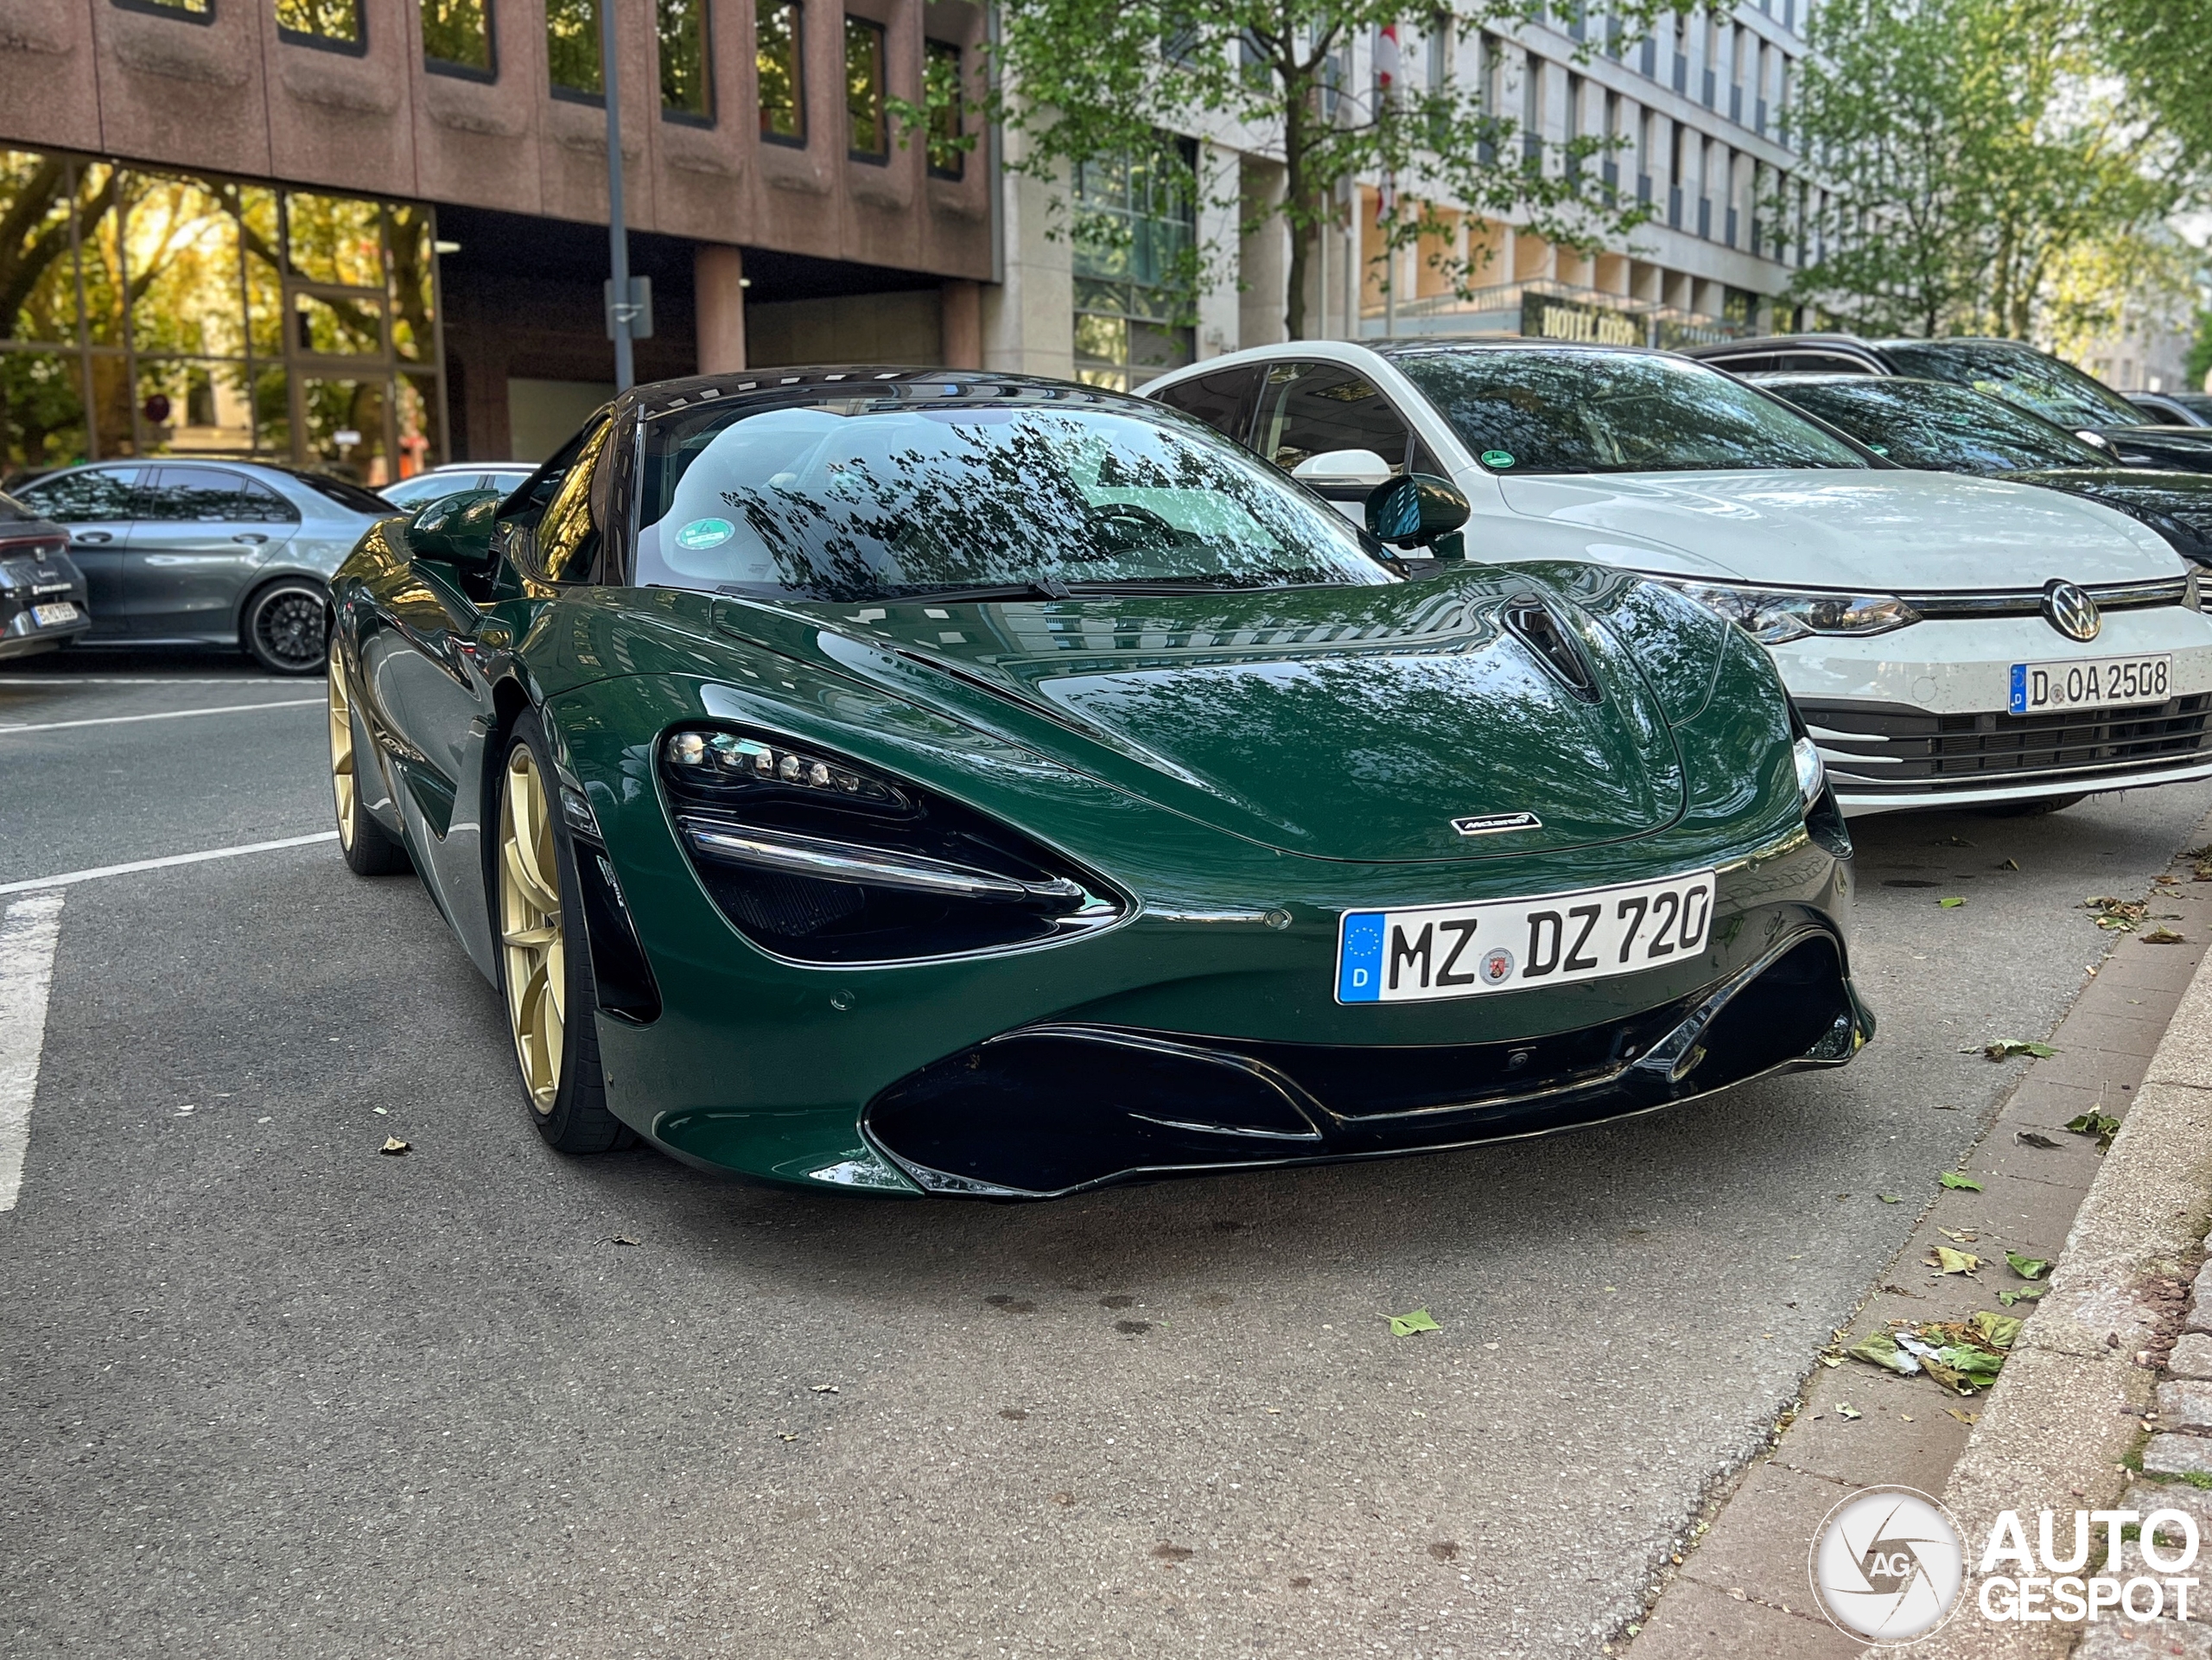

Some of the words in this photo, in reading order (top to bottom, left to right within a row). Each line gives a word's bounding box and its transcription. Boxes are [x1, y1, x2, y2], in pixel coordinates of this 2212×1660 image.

[1542, 305, 1592, 342] HOTEL
[698, 522, 711, 533] 4
[2031, 670, 2049, 705] D
[2067, 665, 2101, 703] OA
[2107, 661, 2167, 699] 2508
[2014, 693, 2022, 704] D
[1465, 817, 1528, 830] McLaren
[1389, 918, 1478, 989] MZ
[1522, 903, 1602, 978] DZ
[1617, 885, 1708, 964] 720
[1352, 968, 1370, 988] D
